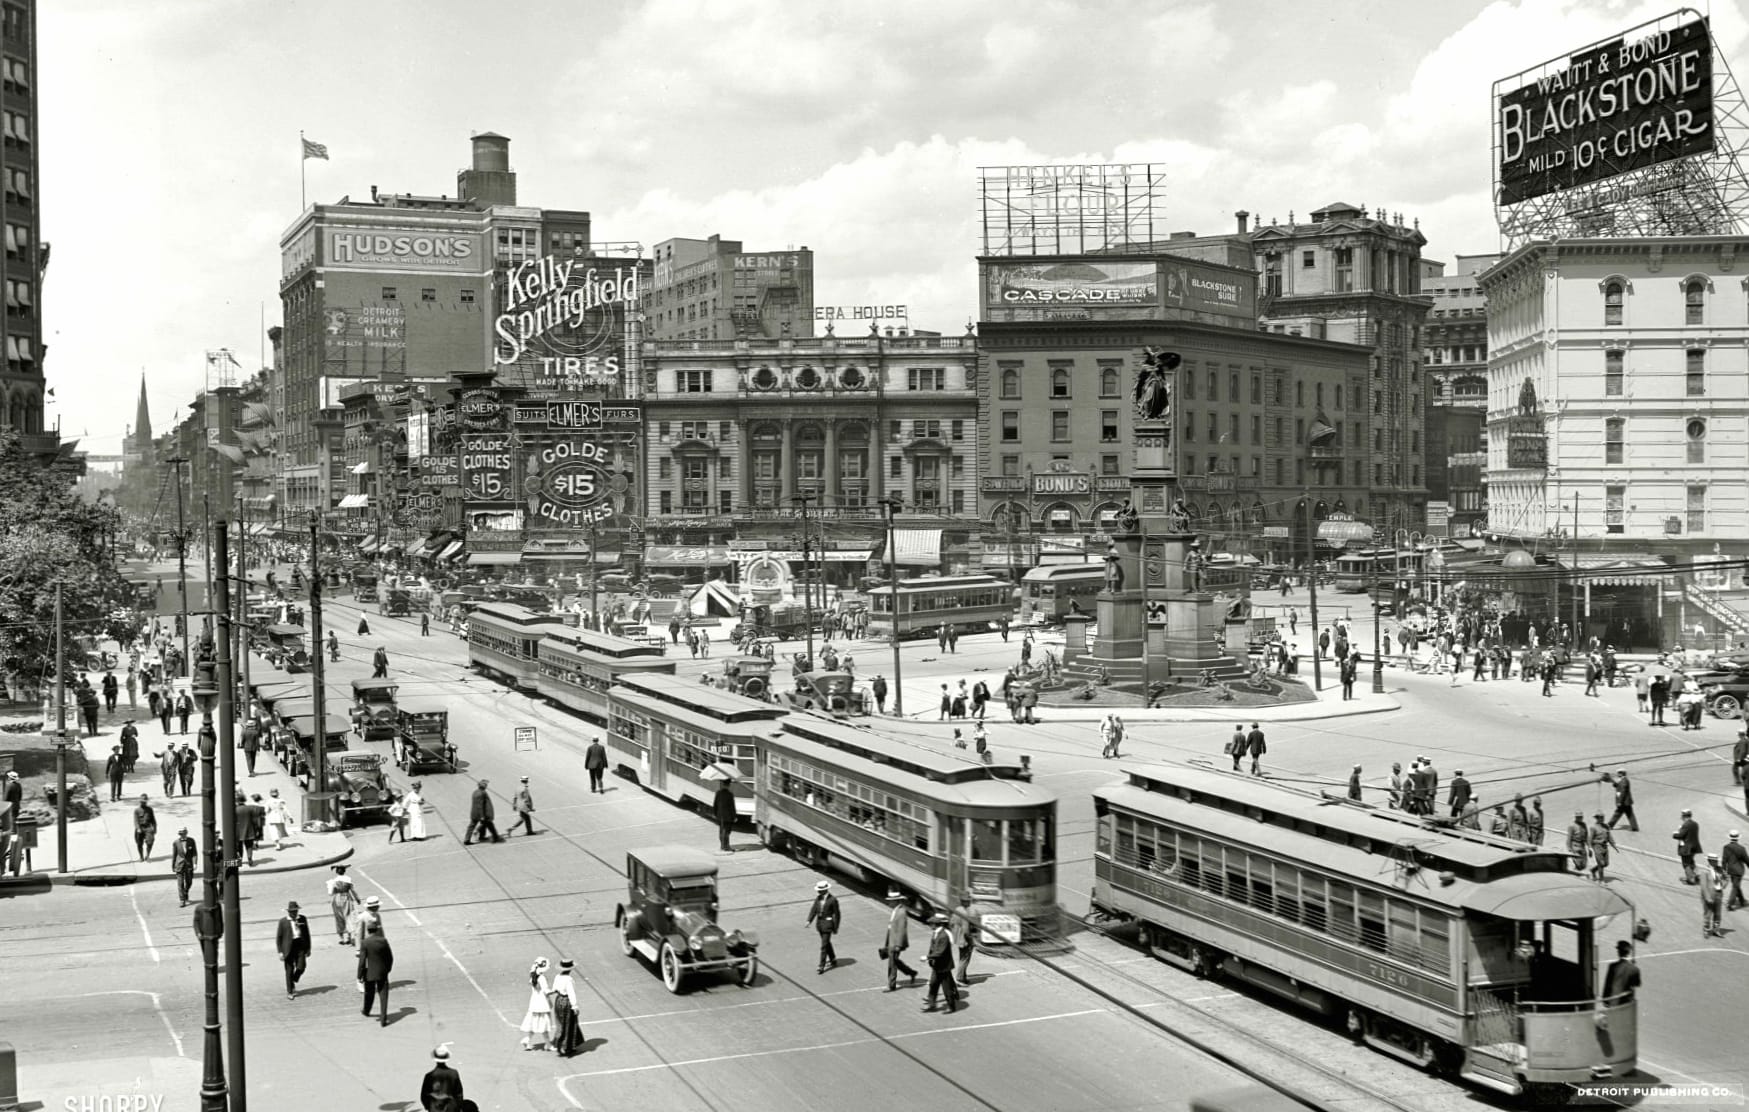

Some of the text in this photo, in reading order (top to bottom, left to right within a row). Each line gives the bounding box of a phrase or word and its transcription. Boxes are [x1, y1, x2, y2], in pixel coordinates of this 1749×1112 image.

[1597, 52, 1609, 75] &
[1619, 30, 1671, 69] BOND
[1502, 50, 1700, 164] BLACKSTONE
[1528, 149, 1566, 174] MILD
[1613, 109, 1708, 158] CIGAR
[1031, 194, 1119, 216] FLOUR
[333, 233, 472, 262] HUDSON'S
[423, 257, 461, 266] DETROIT
[734, 254, 799, 268] KERN'S
[506, 254, 584, 312] Kelly-
[1191, 278, 1237, 294] BLACKSTONE
[1004, 289, 1122, 301] CASCADE
[363, 306, 400, 315] DETROIT
[493, 267, 639, 365] Springfield
[852, 304, 906, 320] HOUSE
[357, 316, 405, 326] CREAMERY
[364, 327, 400, 338] MILK
[540, 356, 620, 376] TIRES
[461, 403, 501, 413] ELMER'S
[516, 402, 635, 427] SUITS ELMER'S FURS
[468, 440, 504, 451] GOLDE
[542, 441, 609, 463] GOLDE
[421, 456, 458, 468] GOLDE
[463, 454, 511, 470] CLOTHES
[421, 474, 458, 485] CLOTHES
[471, 473, 501, 495] $15
[554, 474, 595, 496] $15
[1035, 475, 1088, 493] BOND'S
[540, 502, 613, 525] CLOTHES
[1325, 513, 1354, 522] TEMPLE
